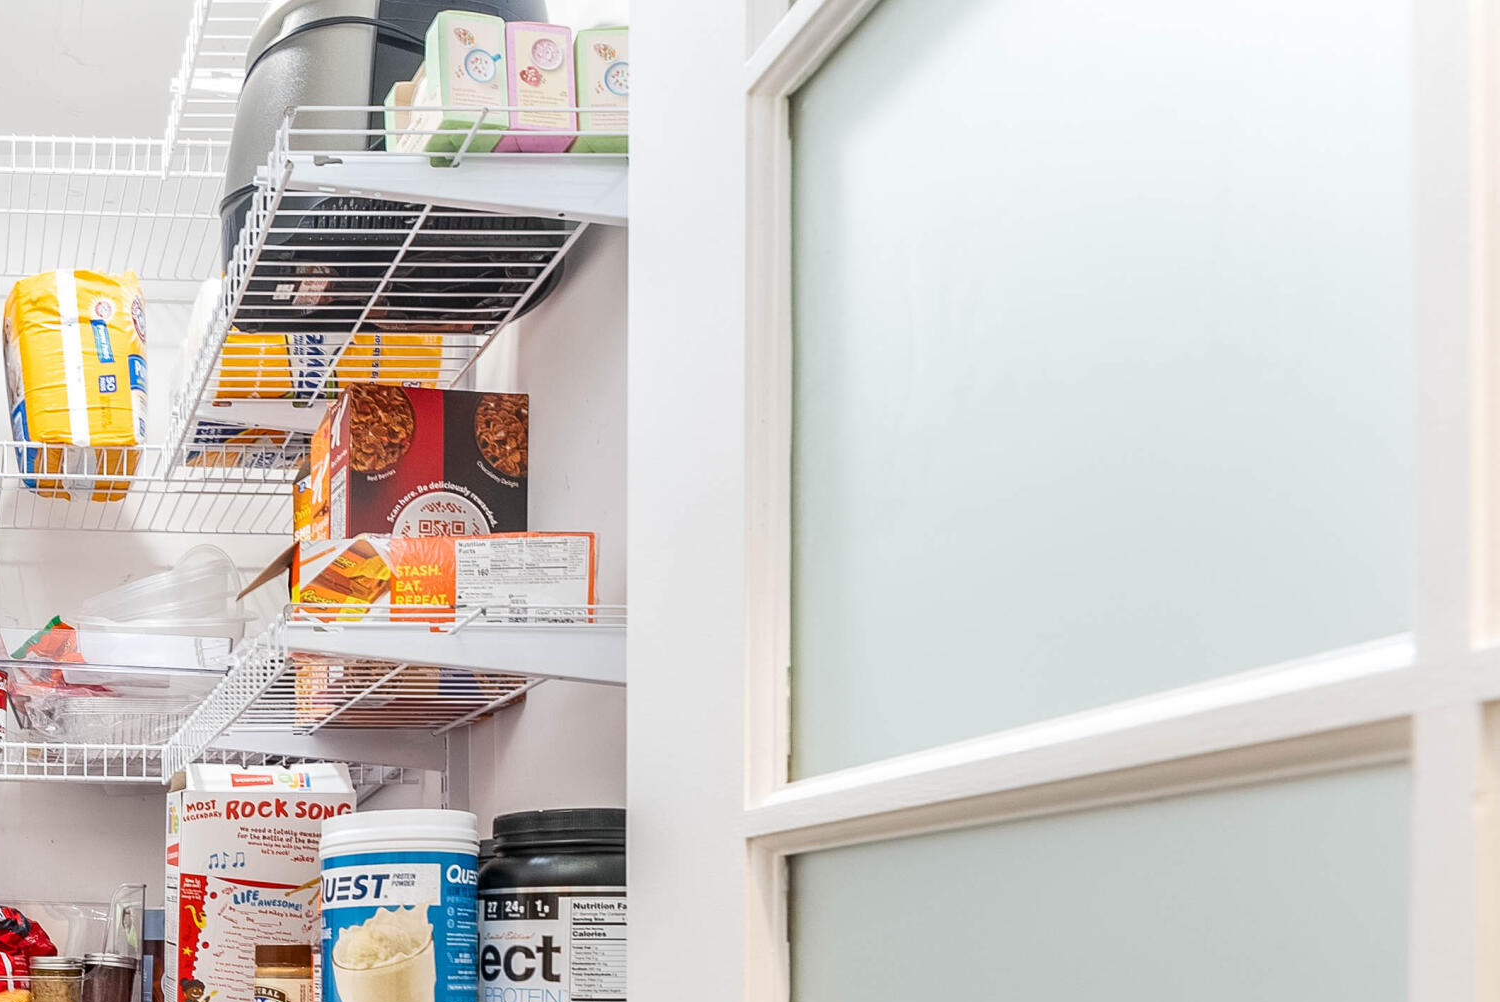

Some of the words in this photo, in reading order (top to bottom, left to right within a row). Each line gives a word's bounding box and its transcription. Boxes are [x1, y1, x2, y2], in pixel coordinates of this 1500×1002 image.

[386, 504, 403, 522] Scan
[401, 490, 418, 504] here.
[417, 484, 428, 493] Be
[429, 481, 472, 496] deliciously
[396, 565, 442, 578] STASH.
[396, 581, 423, 593] EAT.
[186, 800, 217, 813] MOST
[225, 798, 289, 820] ROCK
[295, 801, 352, 820] SONG
[183, 811, 222, 822] LEGENDARY
[233, 890, 260, 904] LIFE
[257, 898, 303, 911] AWESOME!
[487, 901, 498, 913] 27
[505, 900, 525, 914] 24g
[572, 902, 615, 910] Nutrition
